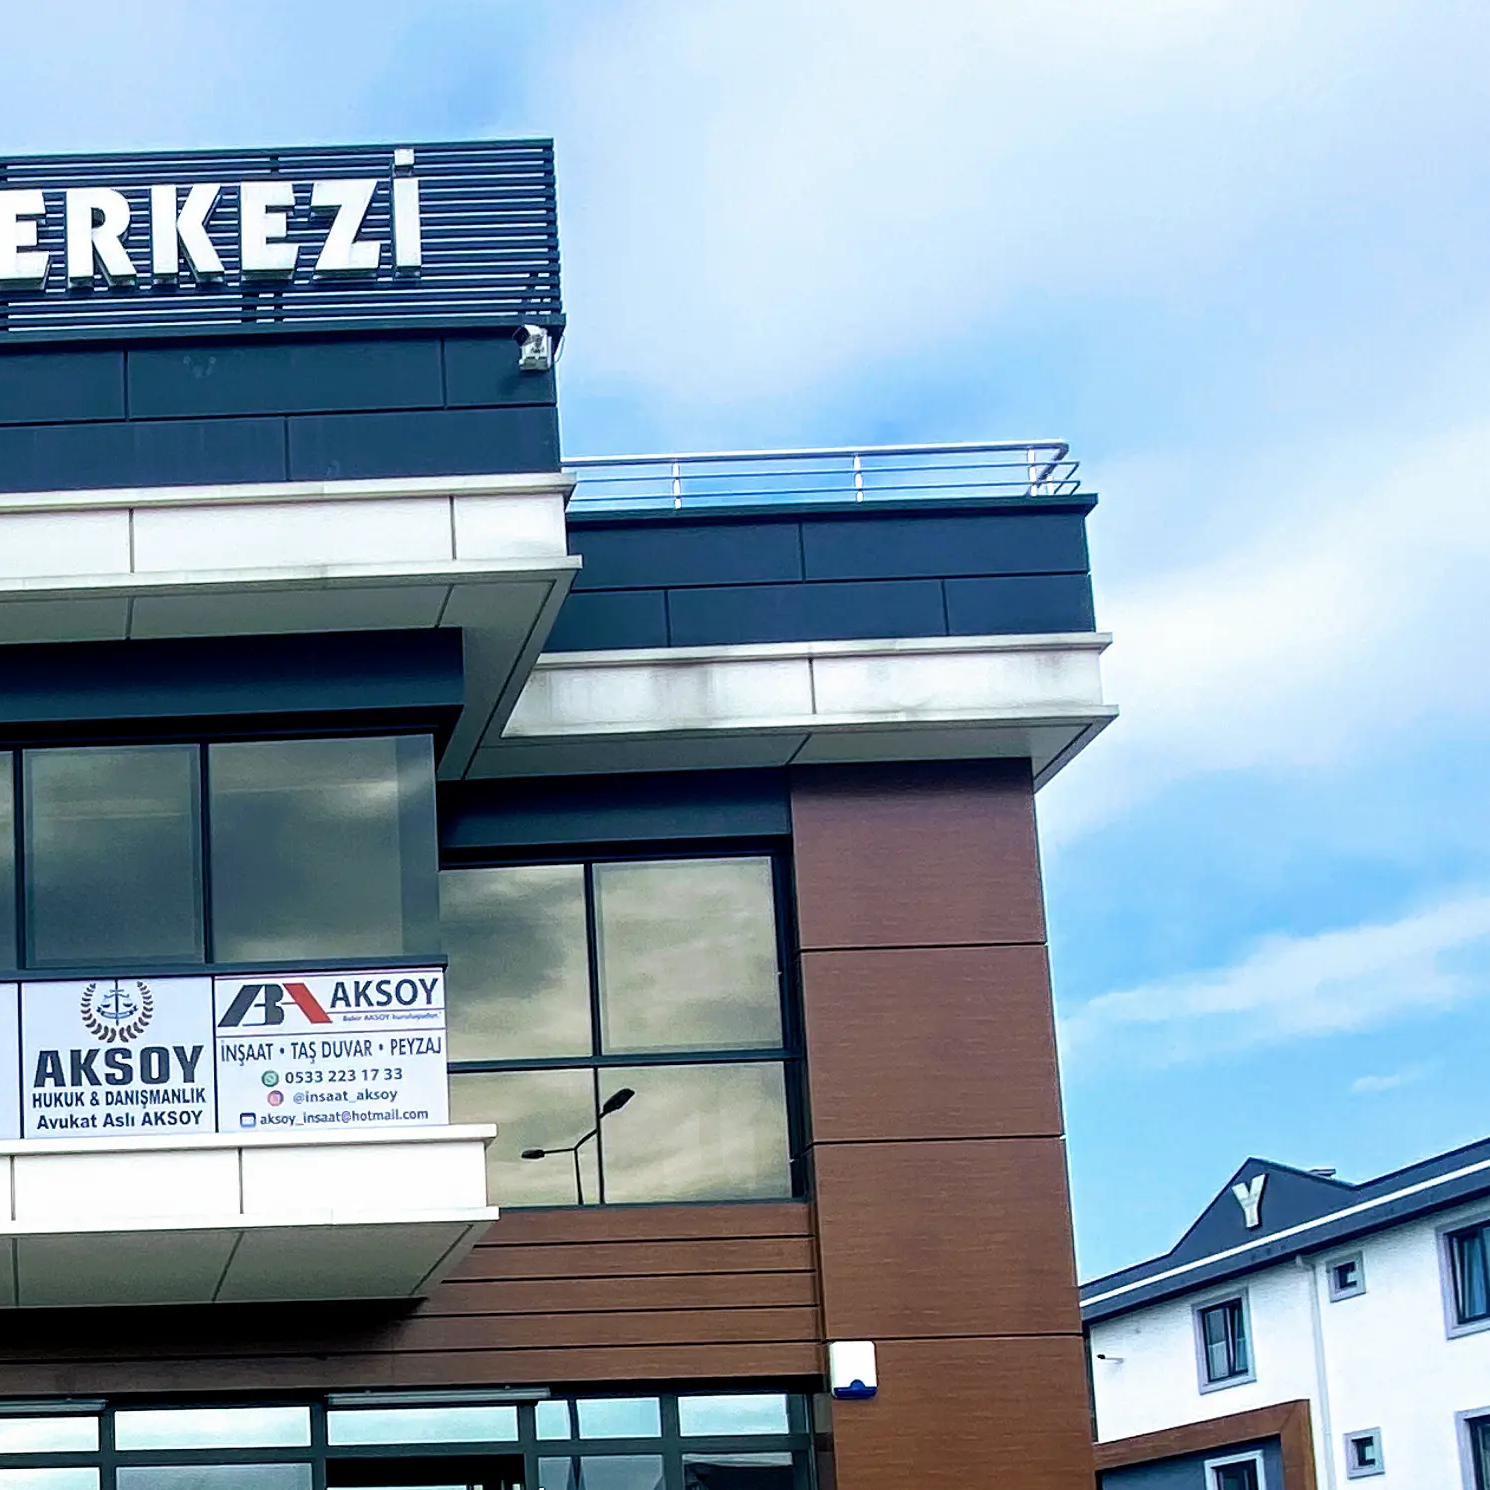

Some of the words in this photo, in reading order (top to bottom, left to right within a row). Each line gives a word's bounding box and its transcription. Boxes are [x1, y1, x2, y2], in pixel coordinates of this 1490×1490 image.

[330, 977, 440, 1008] AKSOY
[221, 1040, 274, 1066] İNŞAAT
[290, 1041, 317, 1064] TAŞ
[321, 1039, 372, 1059] DUVAR
[390, 1036, 441, 1056] PEYZAJ
[33, 1045, 203, 1088] AKSOY
[285, 1070, 324, 1084] 0533
[328, 1069, 357, 1082] 223
[361, 1068, 380, 1081] 17
[383, 1067, 403, 1080] 33
[32, 1091, 85, 1109] HUKUK
[89, 1090, 100, 1107] &
[105, 1086, 207, 1110] DANIŞMANLIK
[293, 1087, 398, 1105] @insaat_aksoy
[36, 1112, 98, 1130] Avukat
[102, 1111, 136, 1128] Aslı
[140, 1109, 203, 1127] AKSOY
[259, 1107, 429, 1126] aksoy_insaat@hotmail.com
